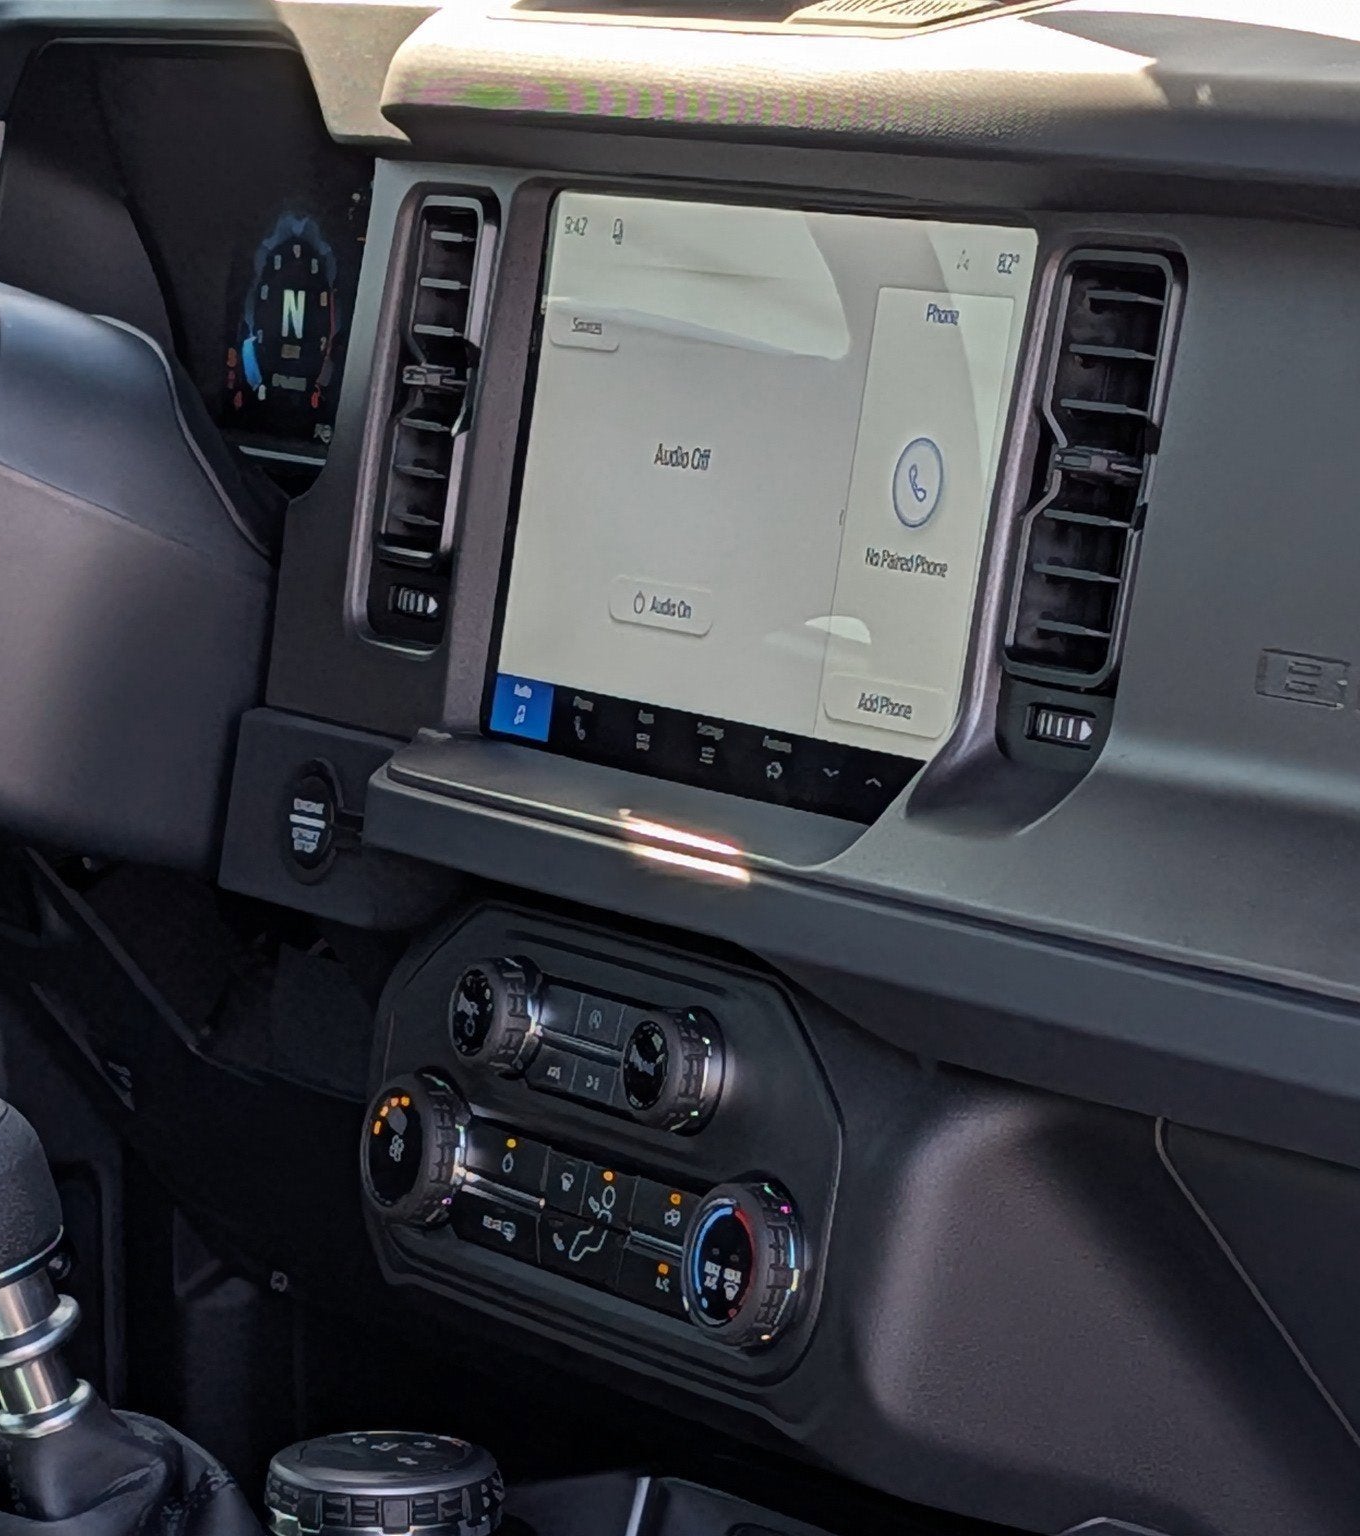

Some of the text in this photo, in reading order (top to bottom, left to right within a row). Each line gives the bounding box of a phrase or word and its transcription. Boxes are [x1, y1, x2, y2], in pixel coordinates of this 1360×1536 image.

[280, 288, 306, 340] N
[925, 302, 960, 326] Phone
[653, 442, 712, 471] Audio Off
[864, 546, 949, 578] No Paired Phone
[649, 594, 692, 619] Audio On
[856, 691, 913, 720] Add Phone
